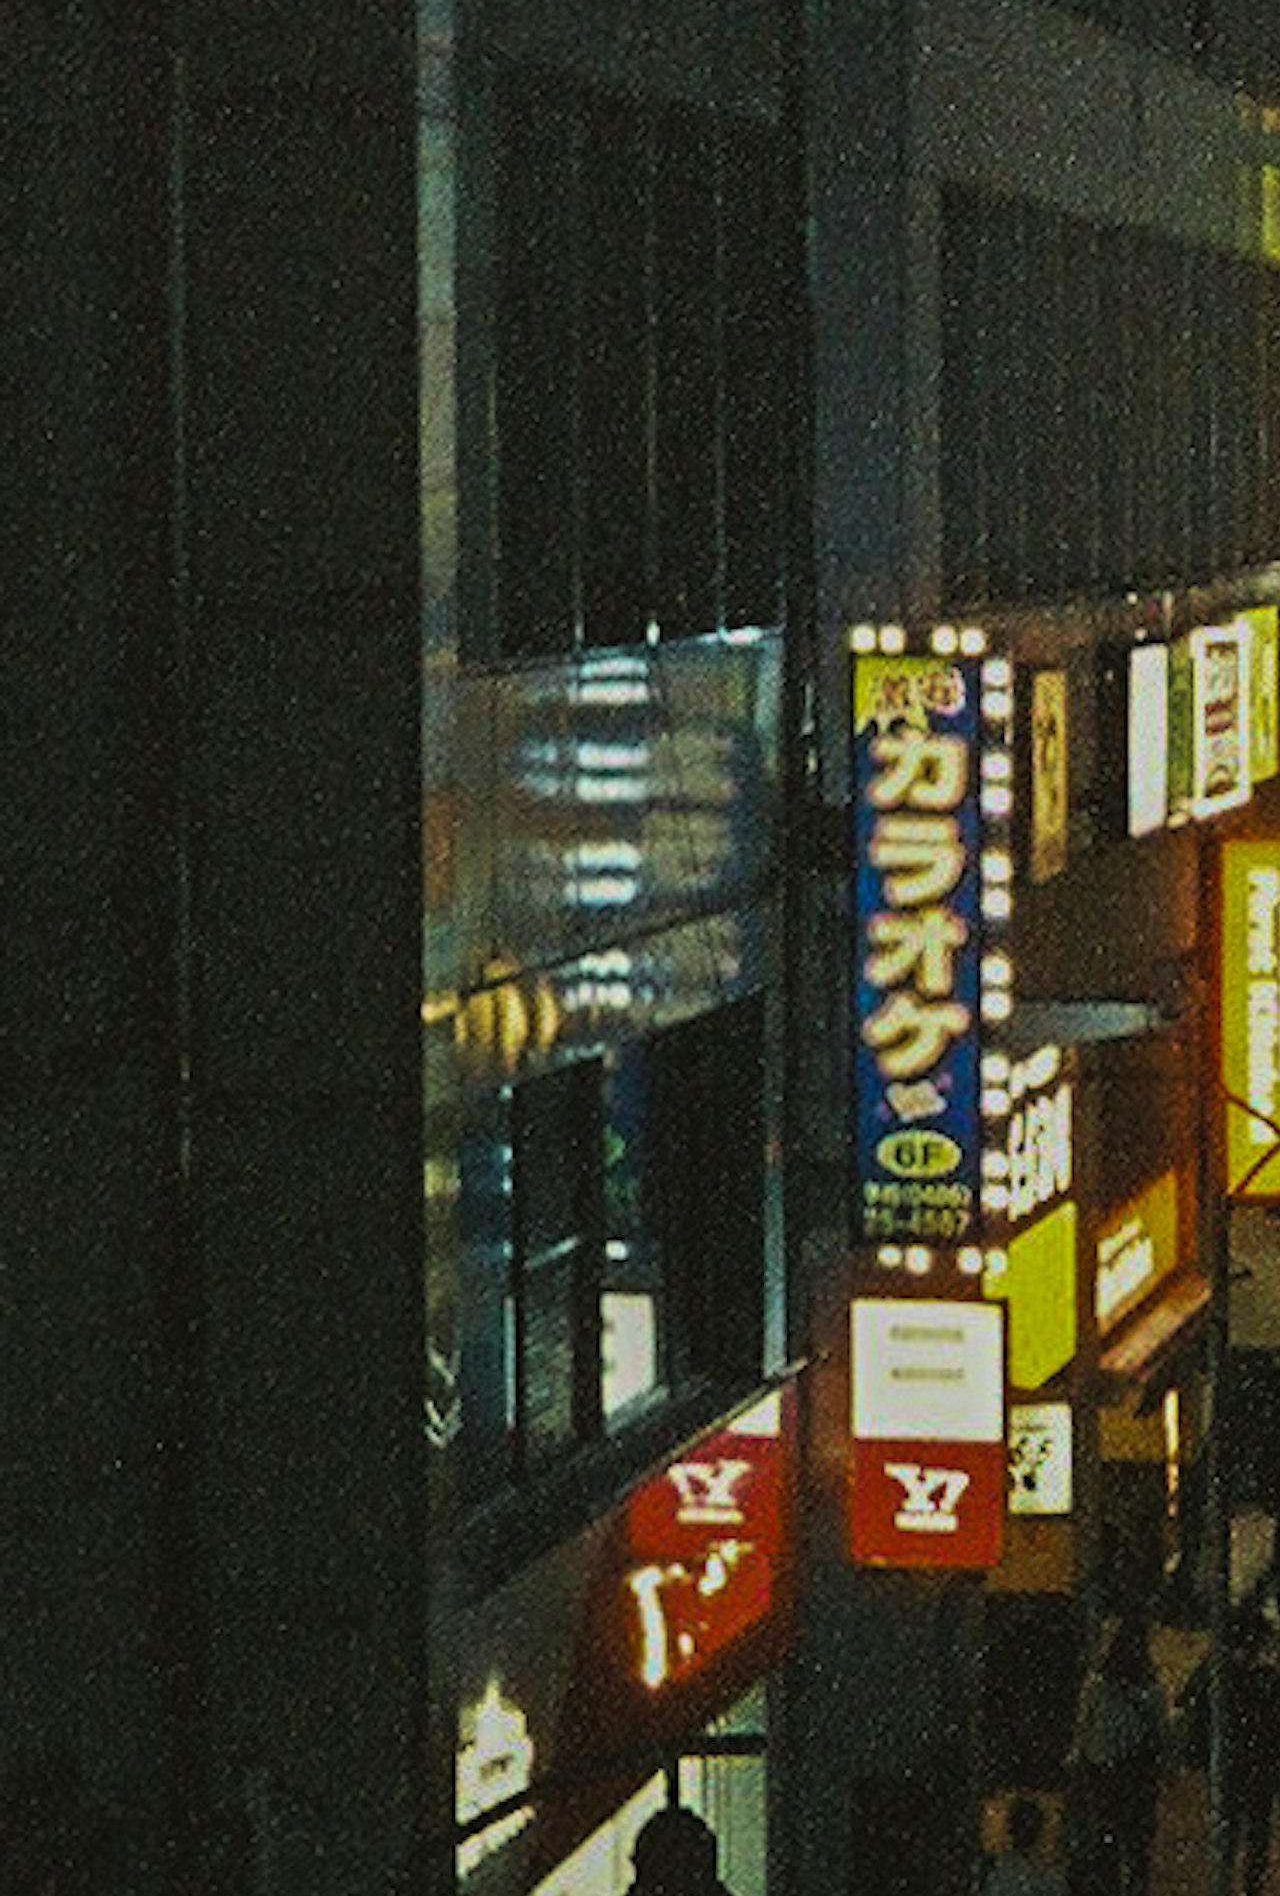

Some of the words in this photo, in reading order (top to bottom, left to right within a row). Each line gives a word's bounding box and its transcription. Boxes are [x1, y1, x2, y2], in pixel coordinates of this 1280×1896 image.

[863, 731, 970, 1077] カラオケ
[895, 1140, 946, 1167] 6F
